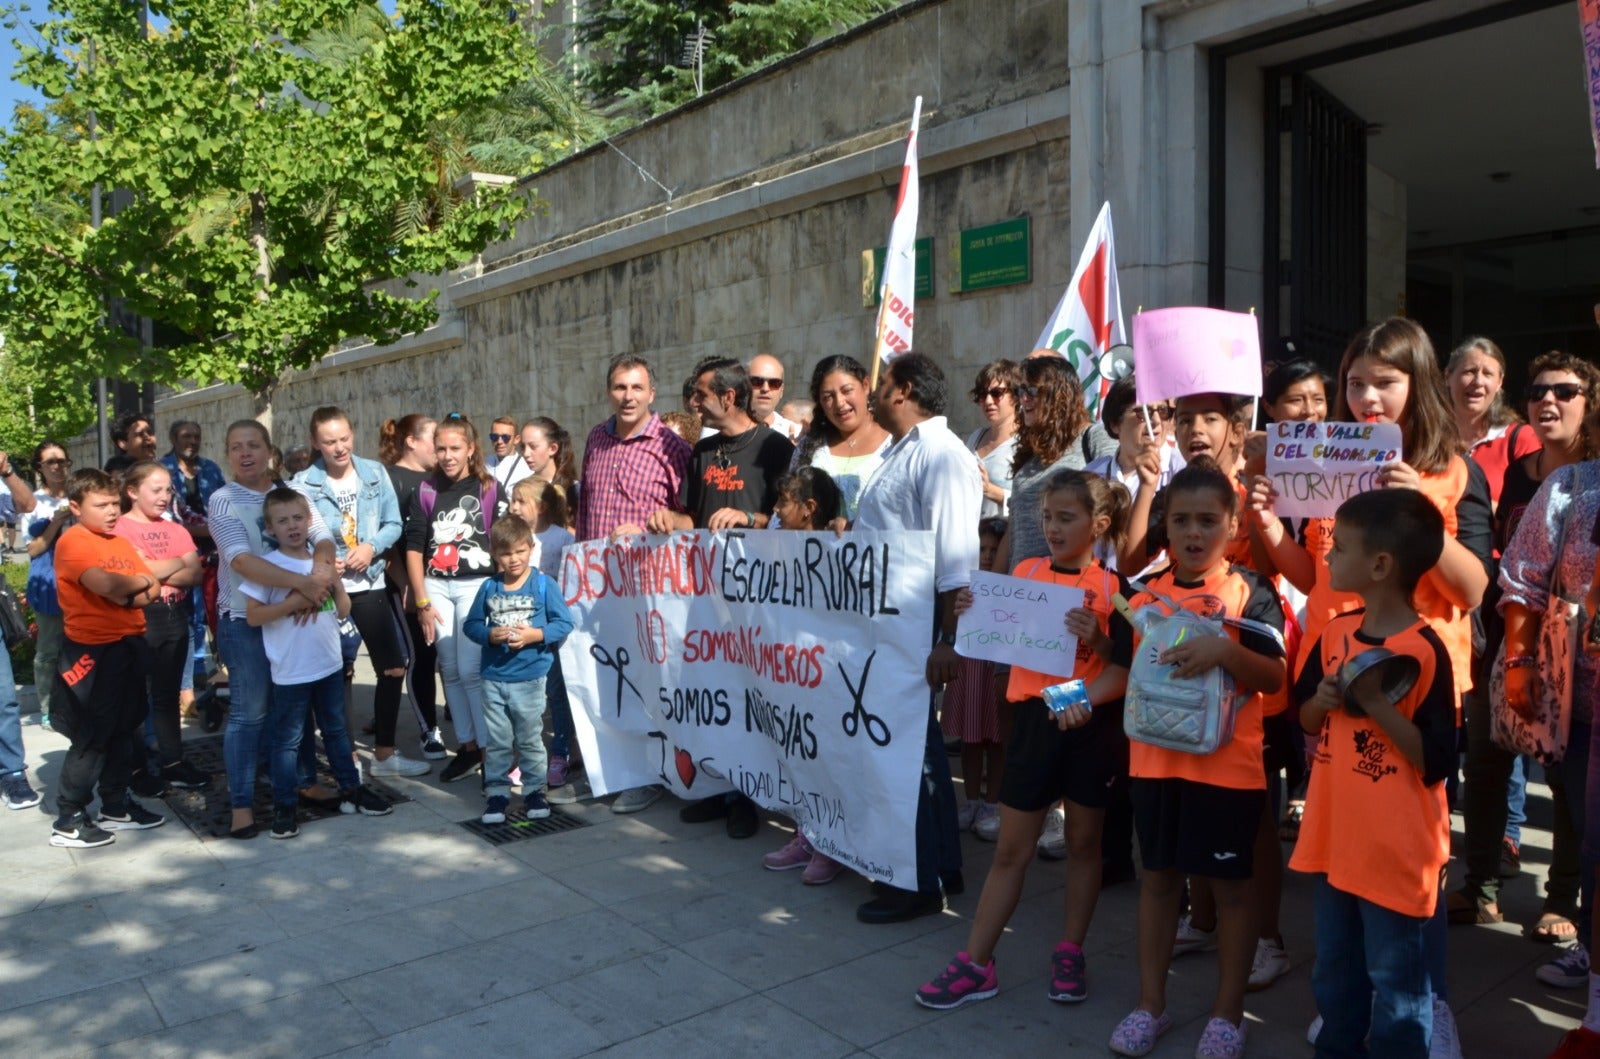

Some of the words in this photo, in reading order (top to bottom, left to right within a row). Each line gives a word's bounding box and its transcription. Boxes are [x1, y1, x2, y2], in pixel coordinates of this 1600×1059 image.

[1326, 424, 1374, 441] VALLE
[1274, 443, 1308, 460] DEL
[721, 531, 805, 607] ESCUELA
[805, 537, 900, 618] RURAL
[991, 608, 1020, 624] DE
[635, 609, 667, 664] NO
[683, 629, 744, 664] SOMOS
[740, 625, 825, 689] NÚMEROS
[61, 653, 97, 687] DAS
[659, 687, 731, 728] SOMOS
[647, 731, 673, 786] I
